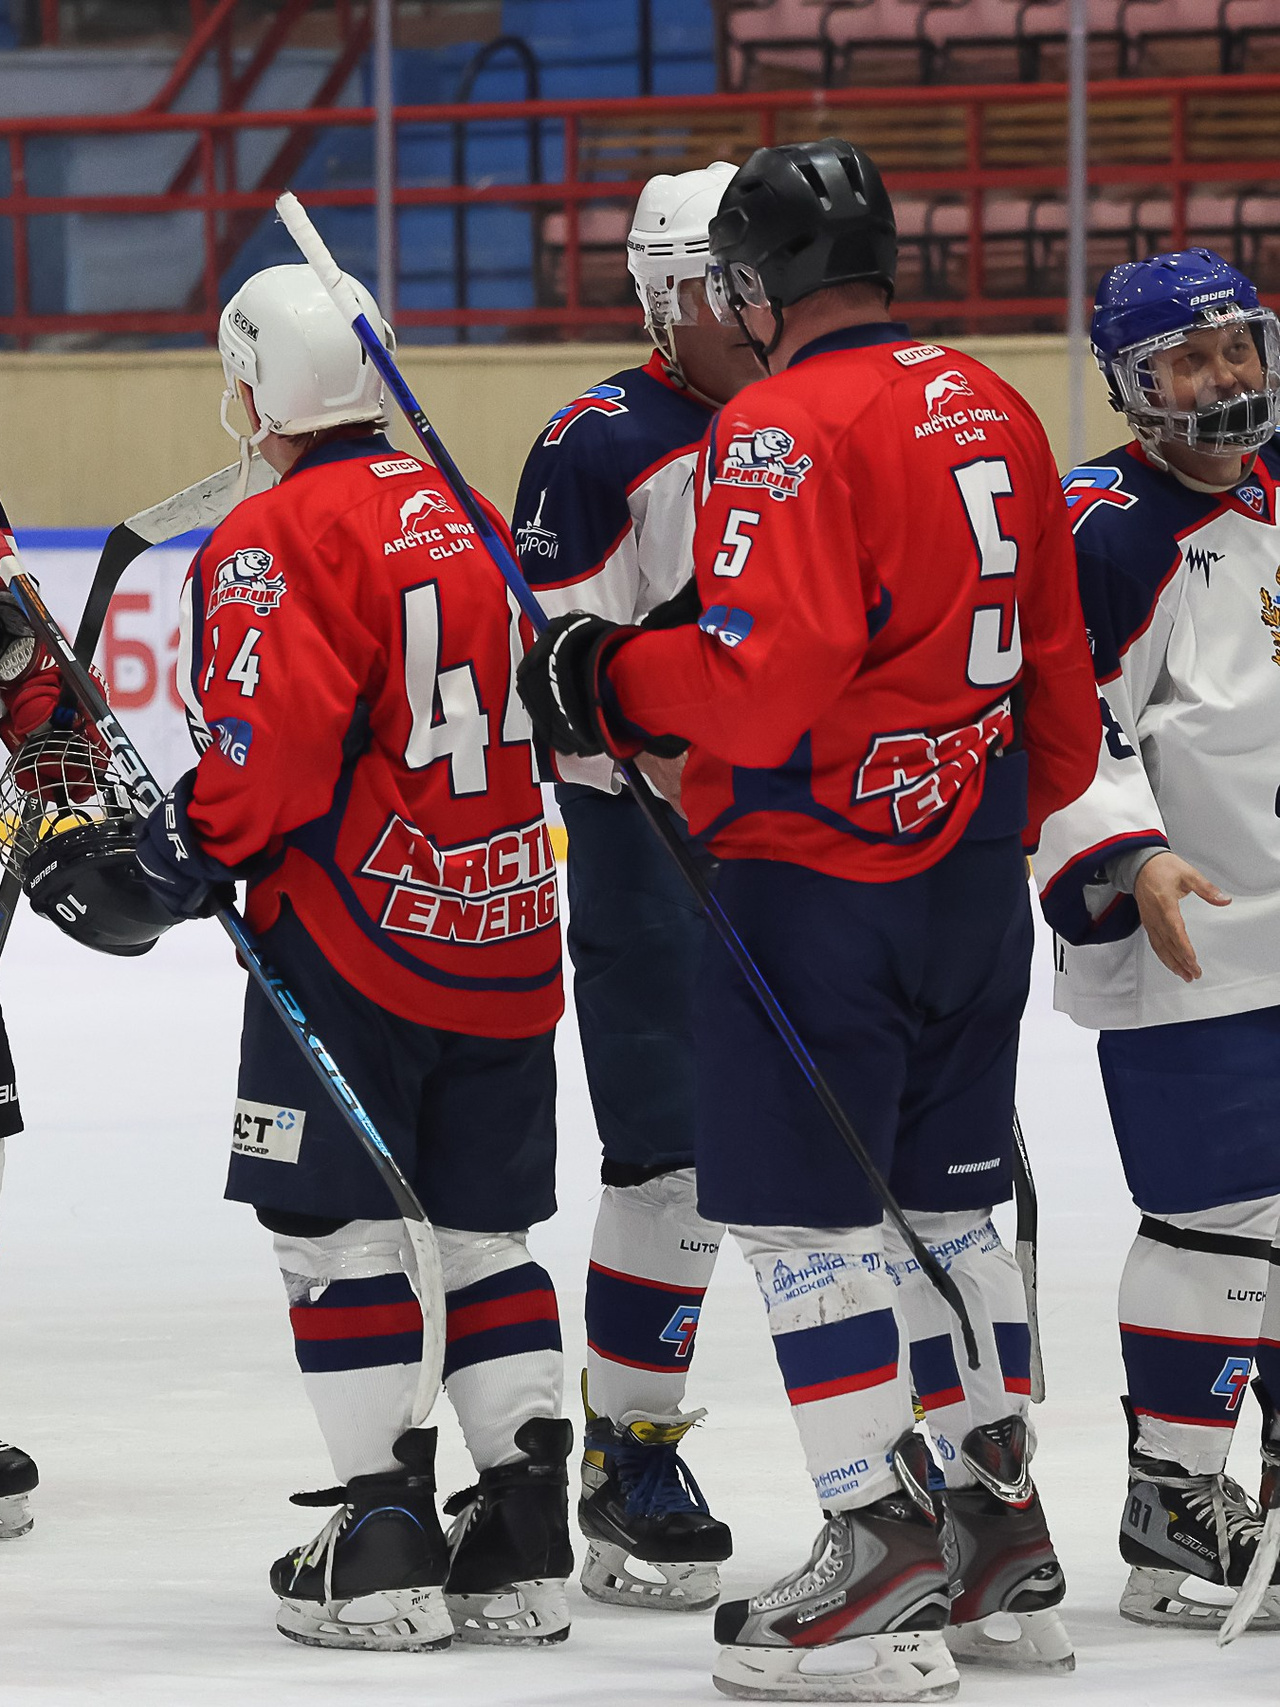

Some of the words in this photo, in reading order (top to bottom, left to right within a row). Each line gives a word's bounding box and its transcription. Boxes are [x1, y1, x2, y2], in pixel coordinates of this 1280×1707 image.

[1189, 287, 1235, 306] BAUER
[233, 311, 259, 340] CCM
[897, 345, 941, 362] LUTCH
[914, 410, 968, 439] ARCTIC
[373, 459, 420, 475] LUTCH
[383, 528, 445, 556] ARCTIC
[712, 507, 761, 579] 5
[949, 456, 1022, 689] 5
[29, 860, 58, 889] BAUER
[55, 893, 88, 922] 10
[947, 1158, 1000, 1175] WARRIOR
[1171, 1530, 1218, 1561] BAUER
